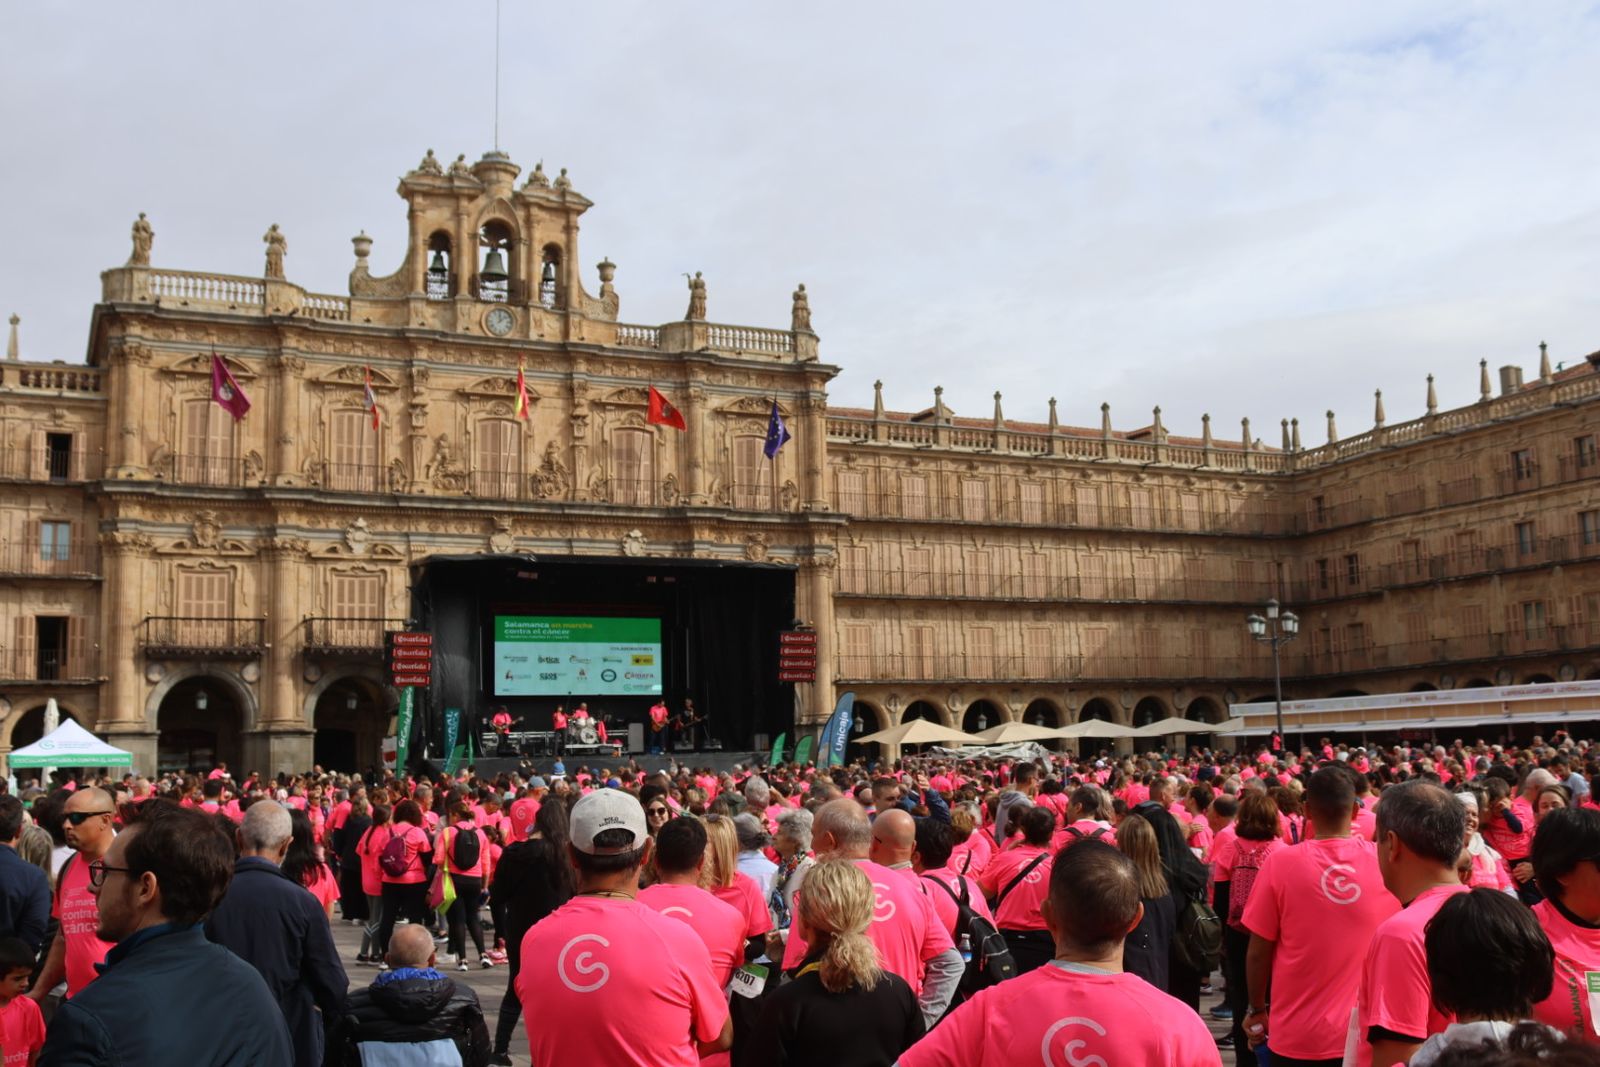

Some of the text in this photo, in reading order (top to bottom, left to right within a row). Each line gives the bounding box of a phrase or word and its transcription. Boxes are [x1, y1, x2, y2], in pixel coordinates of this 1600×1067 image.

[504, 621, 549, 629] Salamanca
[542, 627, 570, 635] cáncer
[835, 711, 849, 752] Unicaja
[63, 899, 74, 909] En
[63, 910, 91, 920] contra
